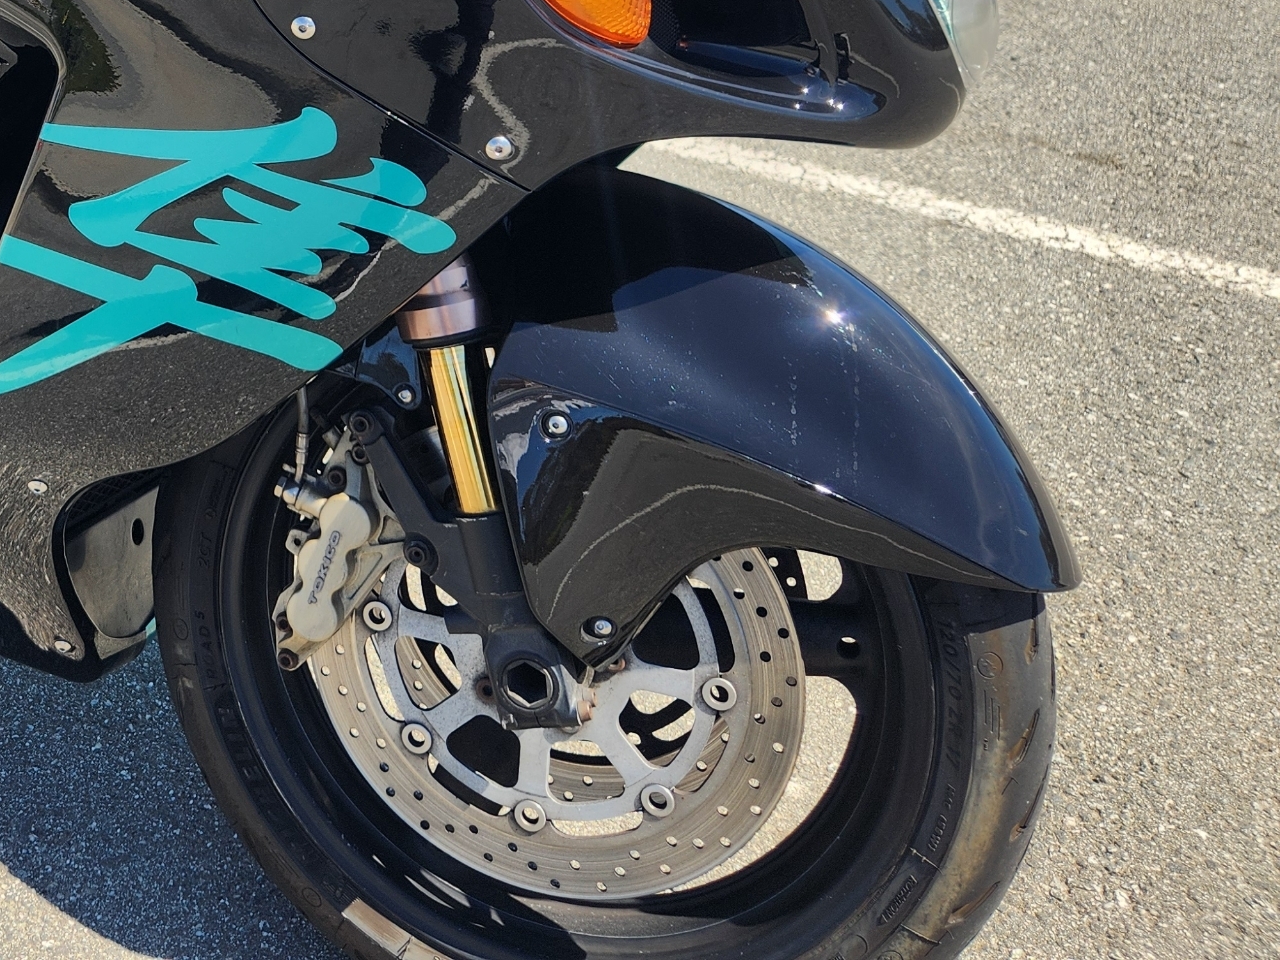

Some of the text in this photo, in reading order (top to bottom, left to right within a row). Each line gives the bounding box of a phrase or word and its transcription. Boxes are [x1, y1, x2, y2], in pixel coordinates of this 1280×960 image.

[308, 530, 342, 606] TOKICO
[198, 625, 217, 680] ROAD
[937, 619, 963, 771] 120/70 ZR 17
[881, 874, 919, 924] ROTATION
